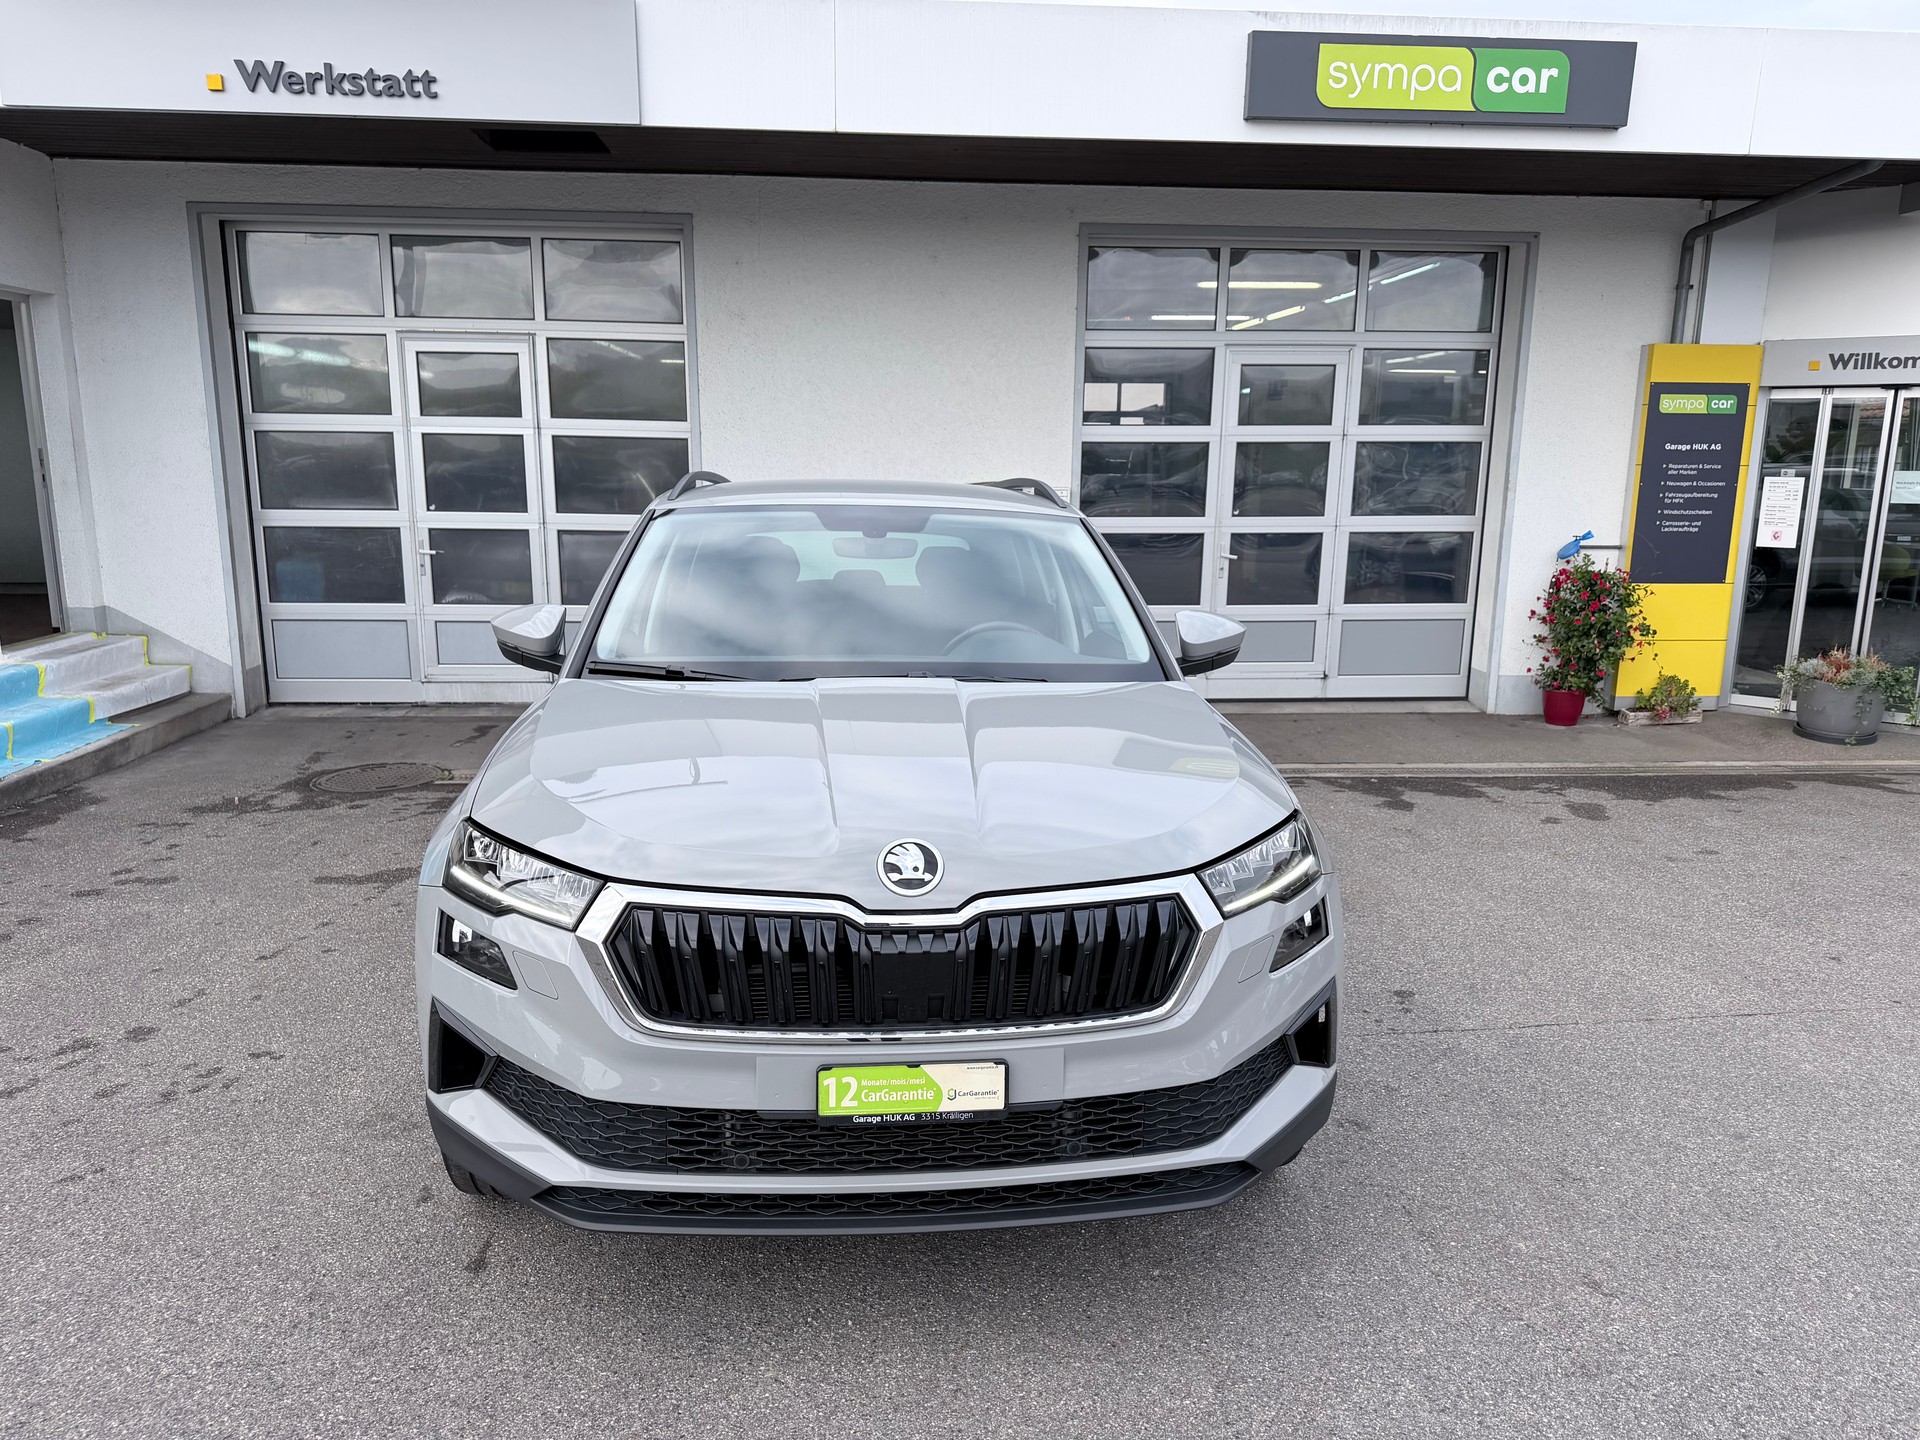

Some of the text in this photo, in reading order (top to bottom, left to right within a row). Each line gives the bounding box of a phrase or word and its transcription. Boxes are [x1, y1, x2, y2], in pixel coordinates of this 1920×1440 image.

[233, 59, 438, 98] Werkstatt
[1328, 60, 1558, 100] sympa car
[1662, 399, 1734, 411] sympa car
[1665, 443, 1691, 451] Garage
[823, 1076, 858, 1108] 12
[852, 1115, 882, 1123] Garage
[883, 1114, 902, 1122] HUK
[903, 1113, 916, 1121] AG
[920, 1112, 941, 1120] 3315
